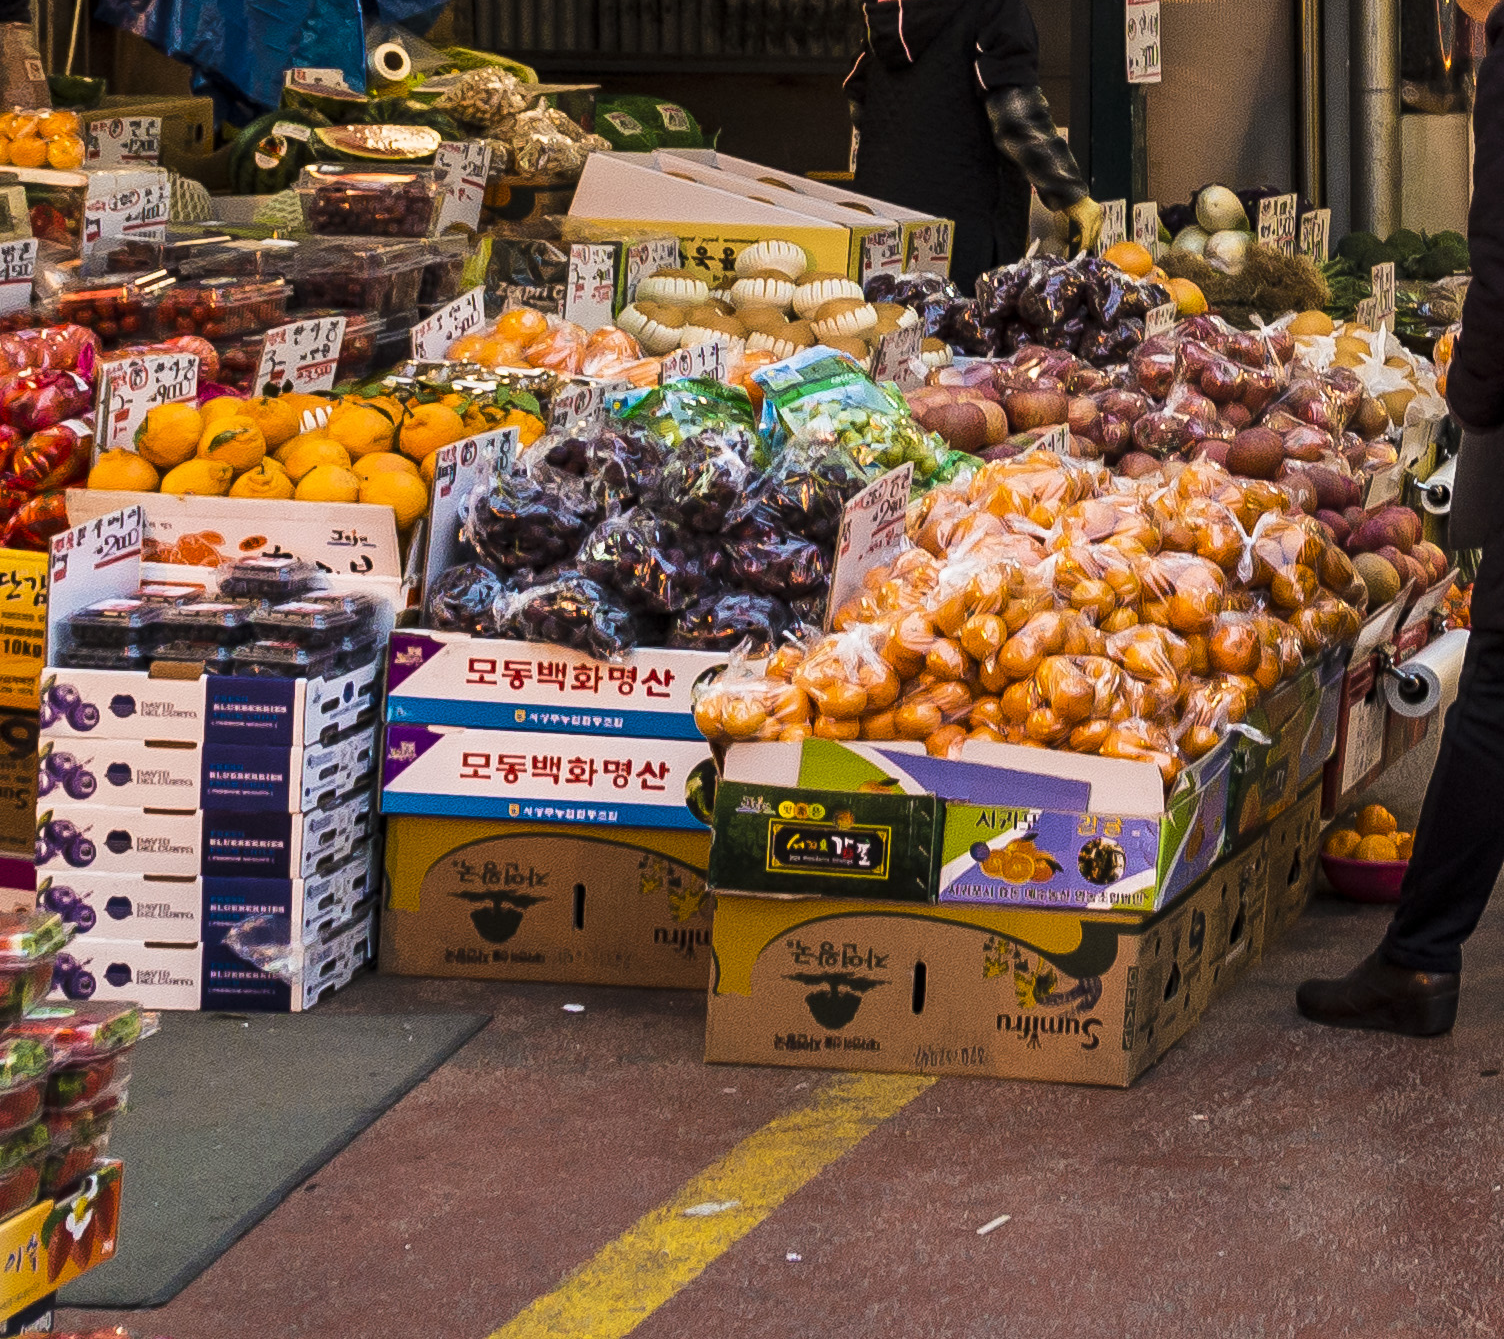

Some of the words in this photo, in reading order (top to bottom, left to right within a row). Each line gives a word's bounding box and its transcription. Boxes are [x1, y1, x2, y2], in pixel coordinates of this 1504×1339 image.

[465, 657, 675, 699] 모동백화명산
[458, 749, 671, 791] 모동백화명산
[793, 941, 888, 970] 자연왕국
[995, 1013, 1104, 1052] Sumifru
